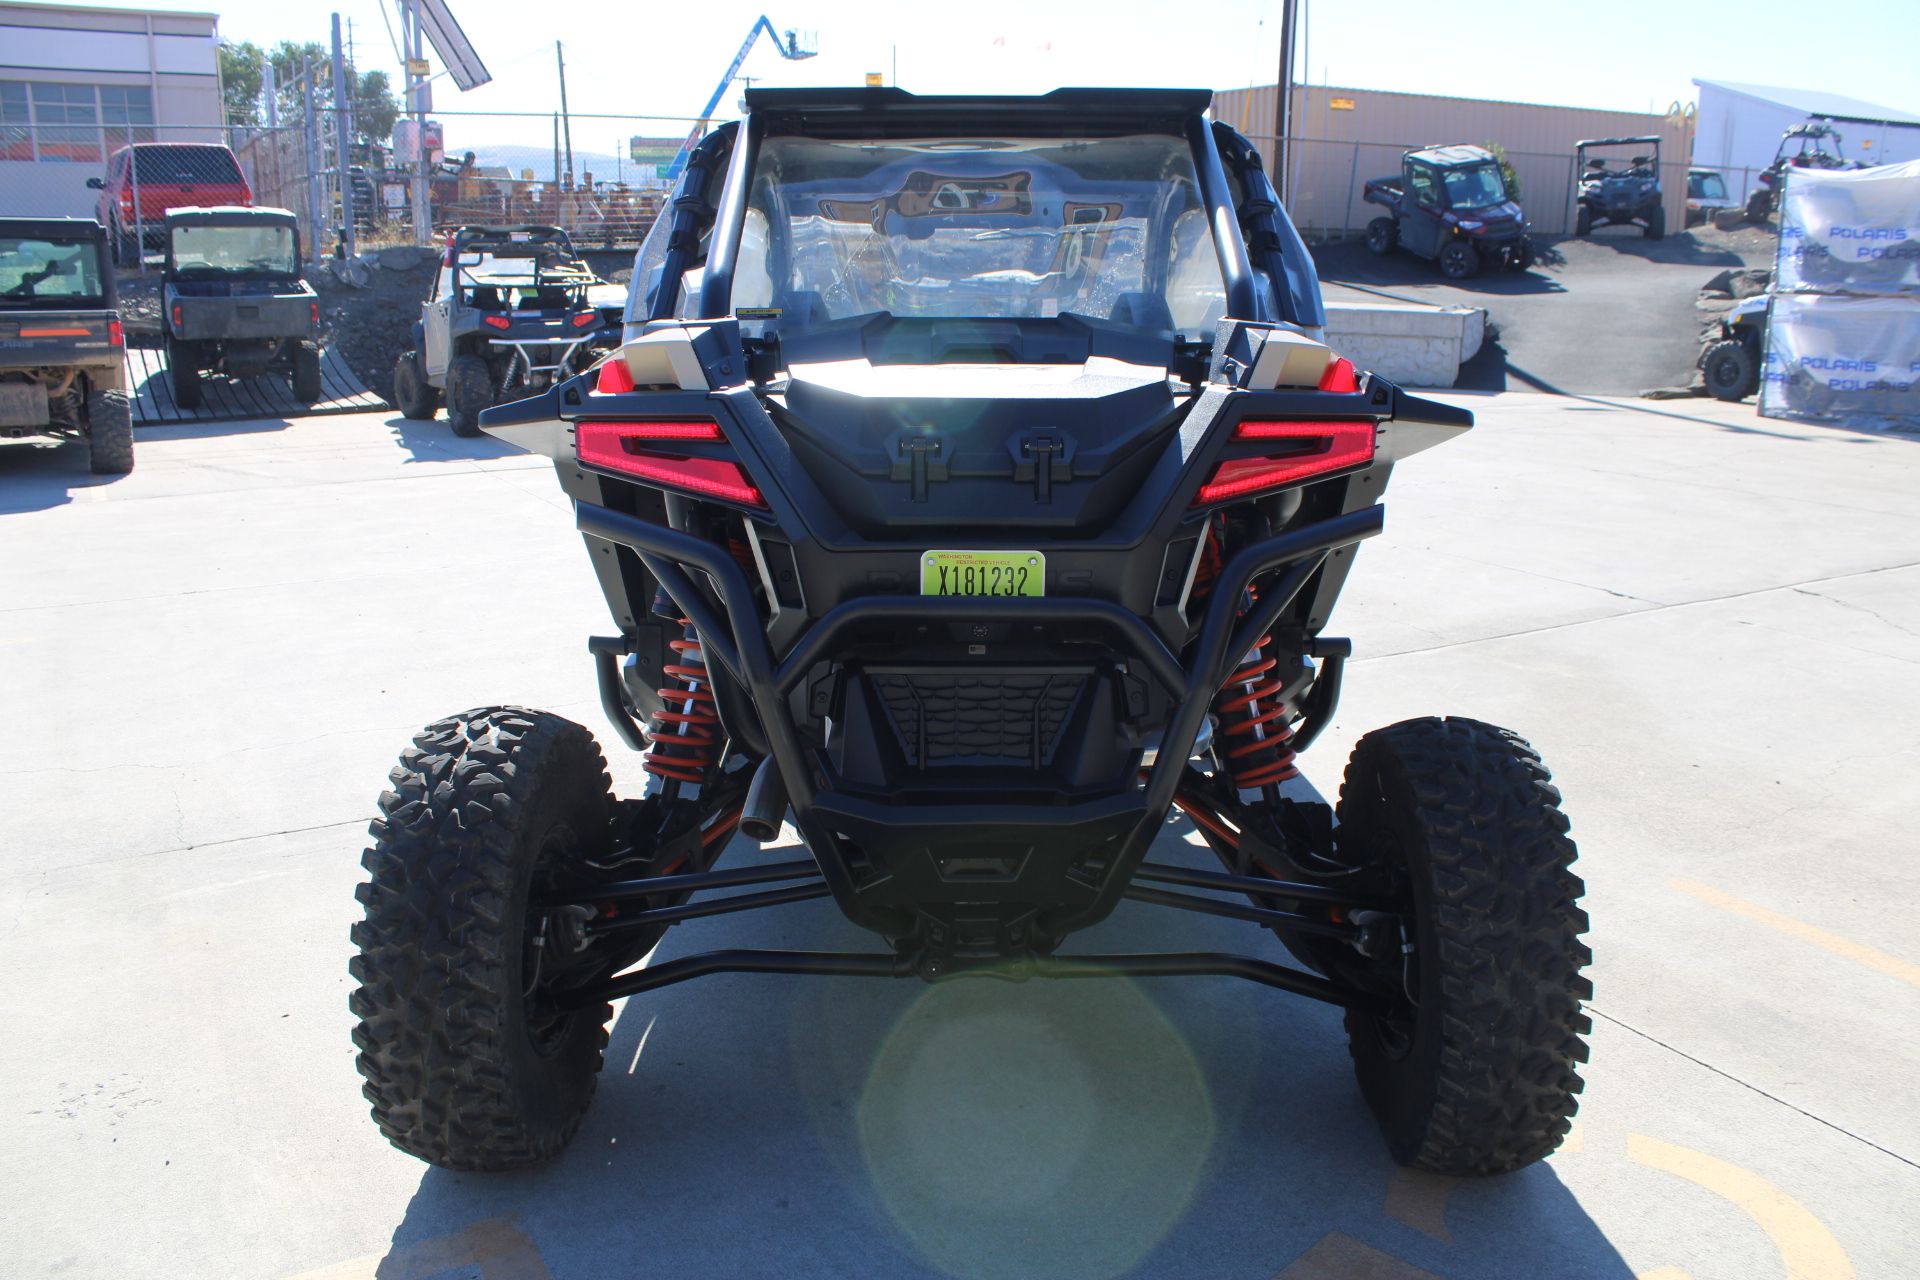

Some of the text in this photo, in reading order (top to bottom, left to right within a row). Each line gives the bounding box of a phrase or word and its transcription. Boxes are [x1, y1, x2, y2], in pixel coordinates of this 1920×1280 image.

[1829, 227, 1907, 240] POLARIS
[1800, 356, 1877, 373] POLARIS
[1828, 378, 1910, 393] POLARIS
[939, 566, 1028, 596] X181232
